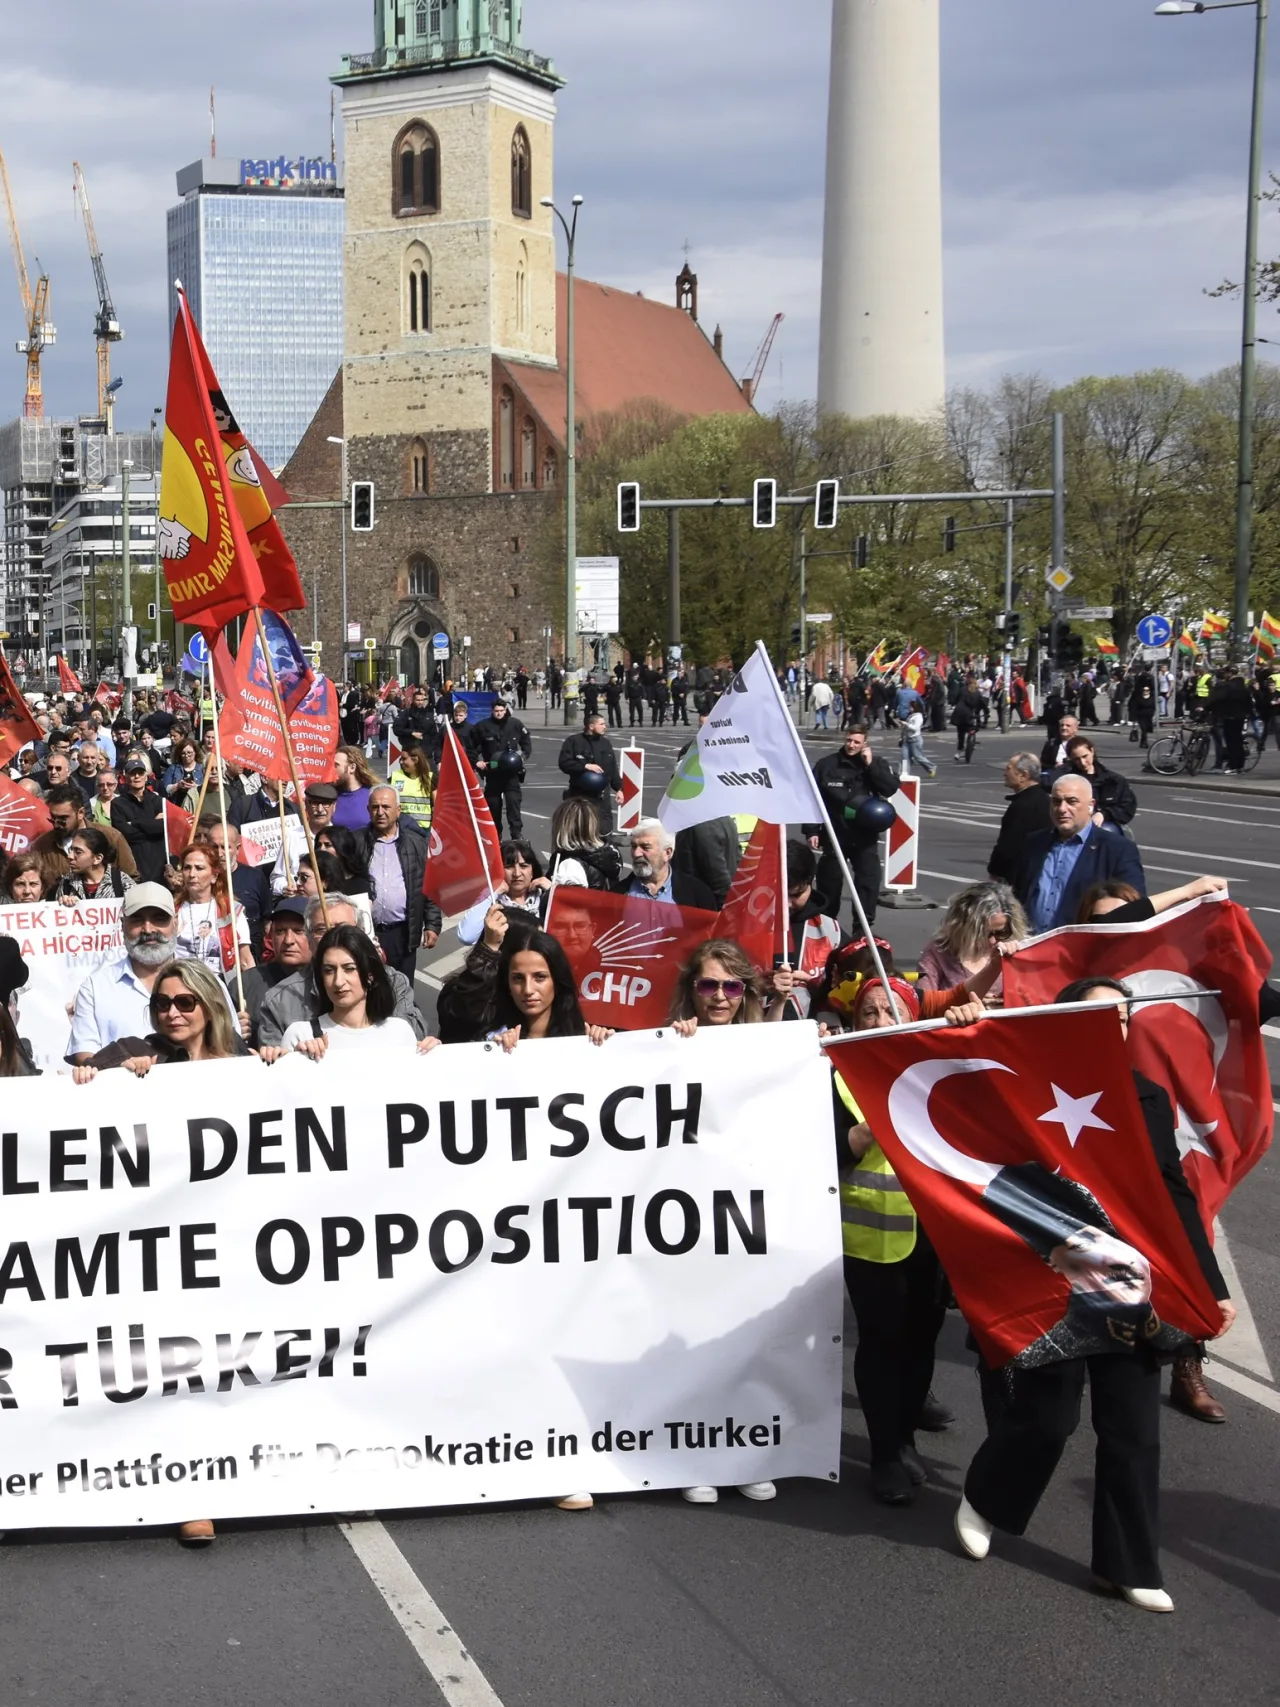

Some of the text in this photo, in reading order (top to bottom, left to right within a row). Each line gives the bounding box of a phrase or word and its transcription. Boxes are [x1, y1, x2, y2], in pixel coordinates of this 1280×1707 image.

[240, 155, 337, 184] park inn
[243, 723, 277, 744] Berlin
[296, 743, 324, 754] Berlin
[1, 910, 47, 931] TEK
[580, 972, 652, 1006] CHP
[187, 1105, 348, 1183] DEN
[385, 1082, 703, 1169] PUTSCH
[255, 1188, 768, 1286] OPPOSITION
[44, 1323, 373, 1407] TÜRKEI!
[56, 1453, 237, 1494] Plattform
[316, 1433, 534, 1473] Dmokratie
[548, 1428, 578, 1458] in
[591, 1420, 654, 1453] der
[663, 1415, 782, 1451] Türkei
